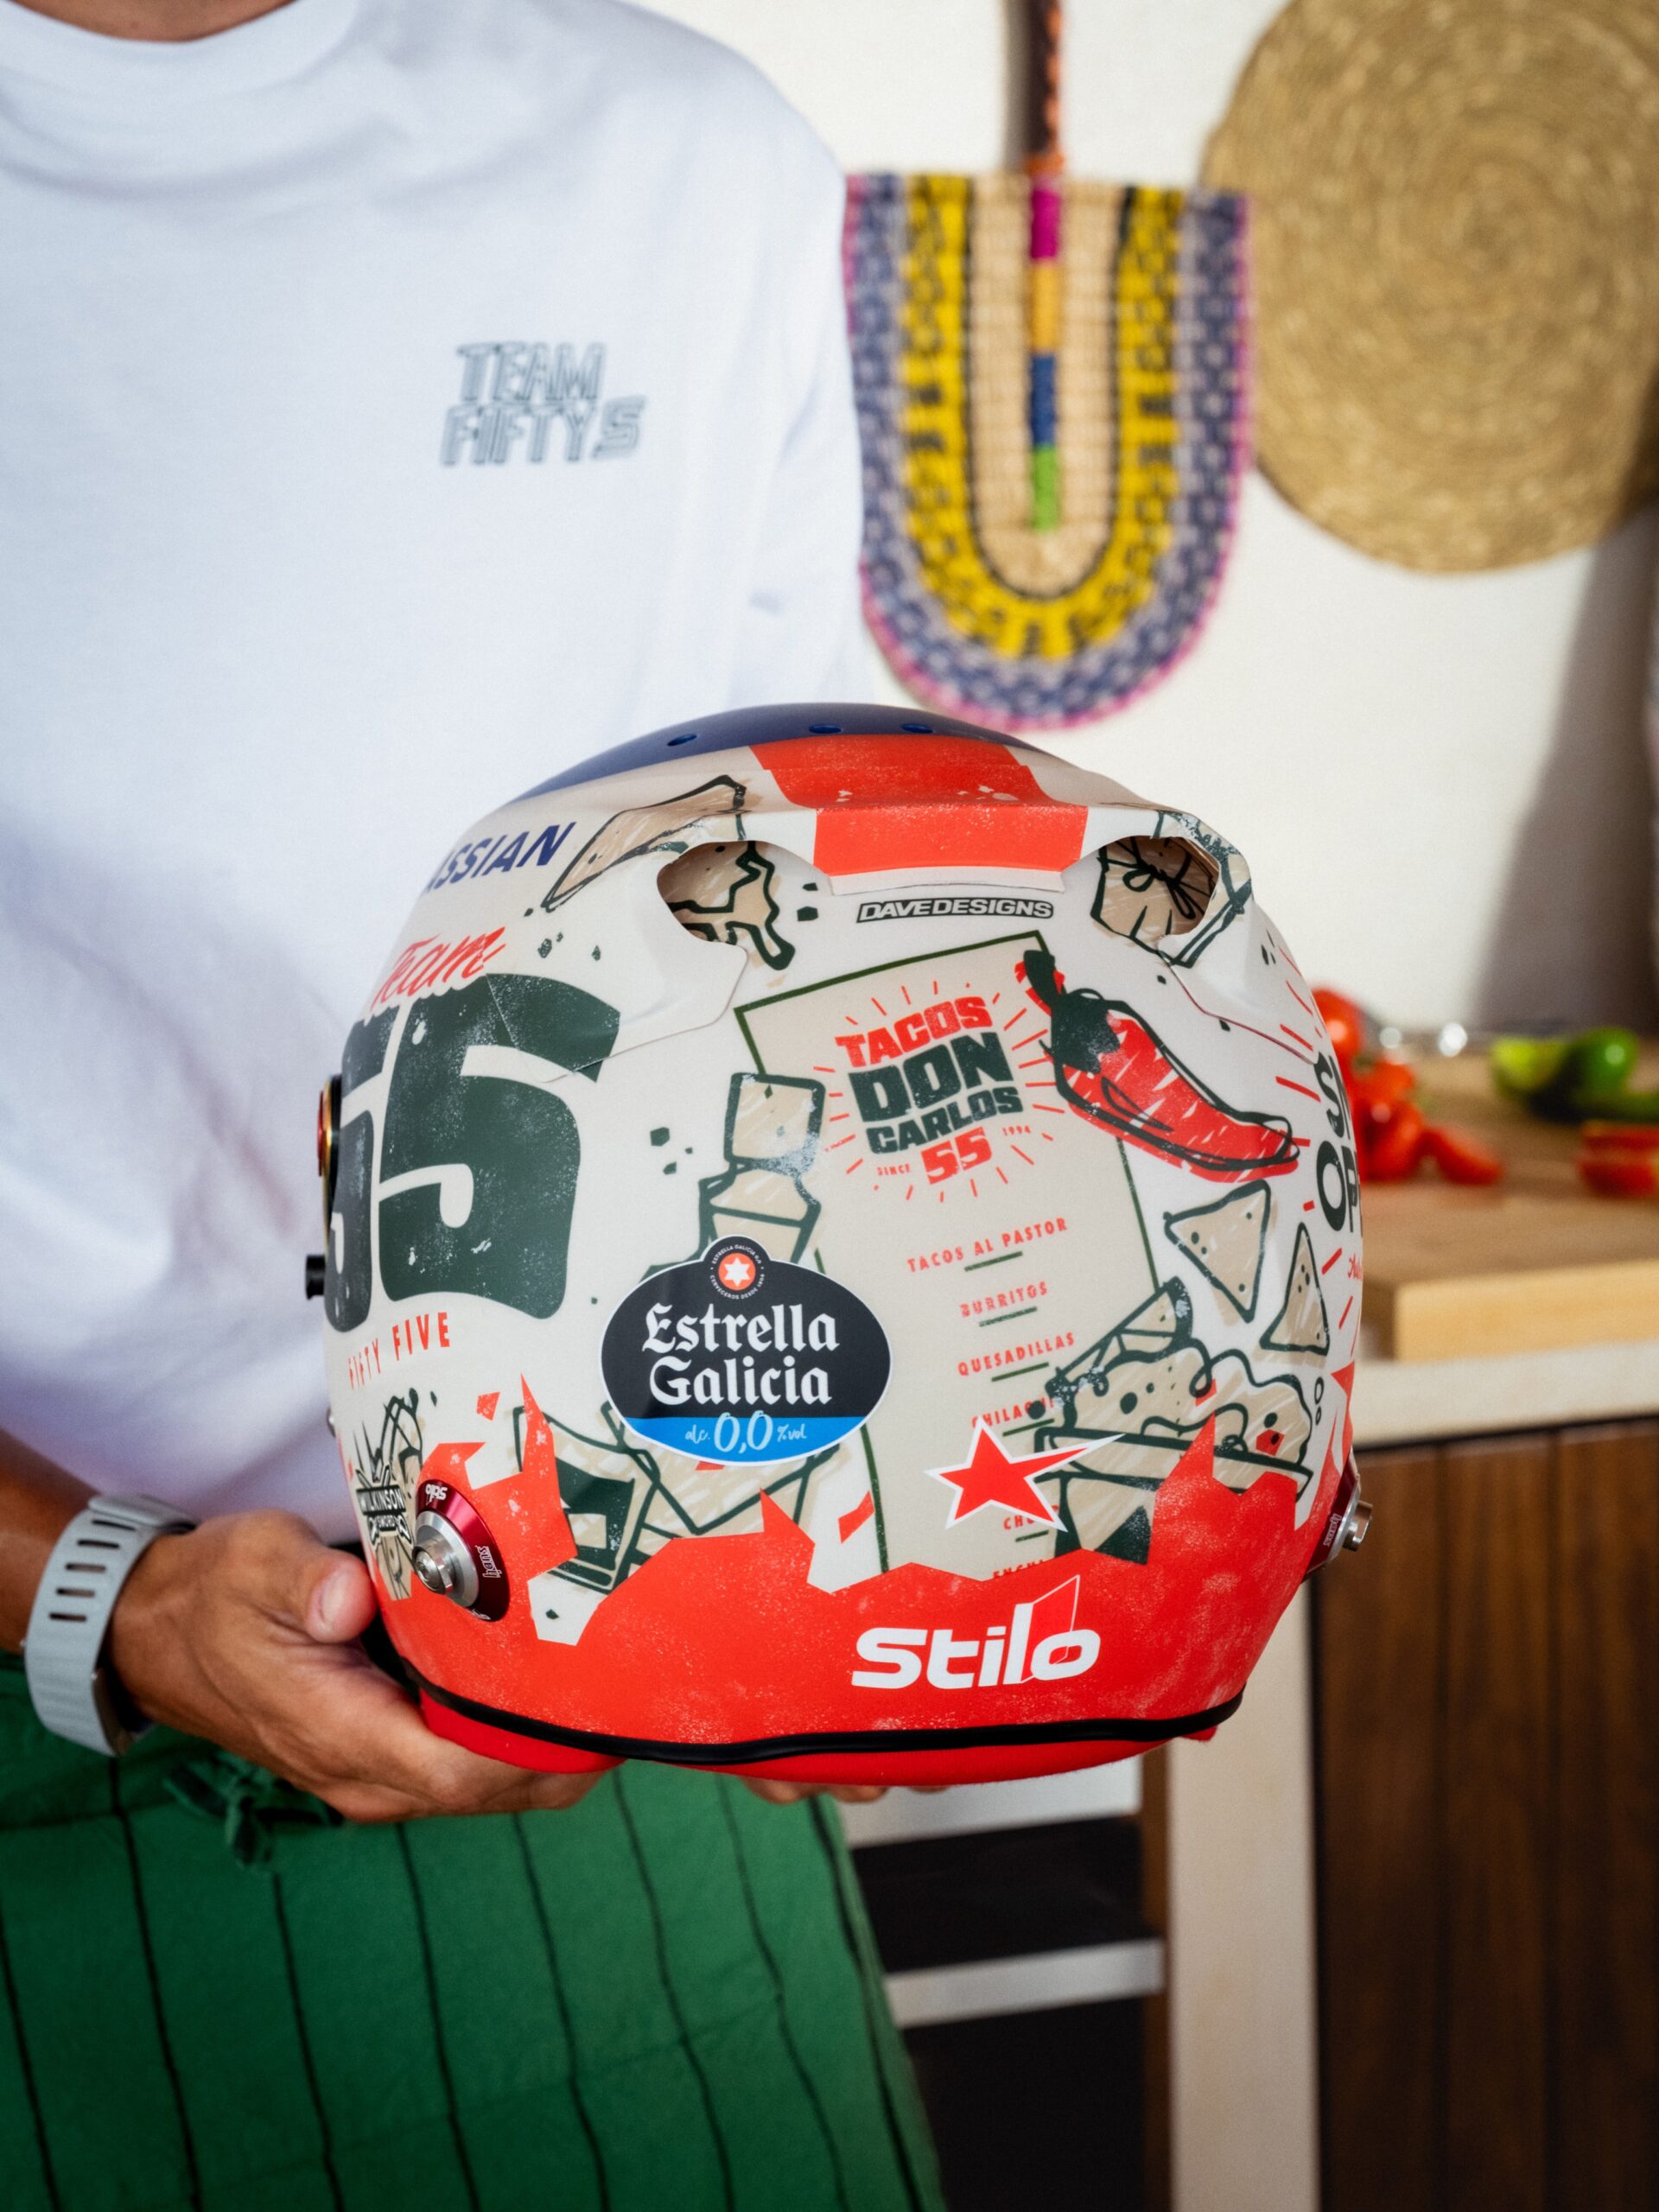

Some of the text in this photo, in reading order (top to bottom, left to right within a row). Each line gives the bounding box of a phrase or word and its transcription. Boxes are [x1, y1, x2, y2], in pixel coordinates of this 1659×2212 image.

[456, 341, 606, 401] TEAM
[428, 822, 576, 893] SSIAN
[835, 996, 993, 1068] TACOS
[848, 1032, 1014, 1122] DON
[866, 1087, 1024, 1154] CARLOS
[877, 1164, 911, 1176] SINCE
[920, 1126, 993, 1185] 55
[712, 1246, 734, 1264] ESTRELLA
[907, 1217, 1068, 1272] TACOS AL PASTOR
[959, 1281, 1048, 1318] BURRITOS
[392, 1312, 450, 1361] FIVE
[642, 1302, 840, 1353] Estrella
[957, 1332, 1075, 1376] QUESADILLAS
[650, 1355, 833, 1406] Galicia
[685, 1424, 711, 1444] alc.
[714, 1410, 774, 1453] 0,0
[851, 1600, 1101, 1689] Stilo
